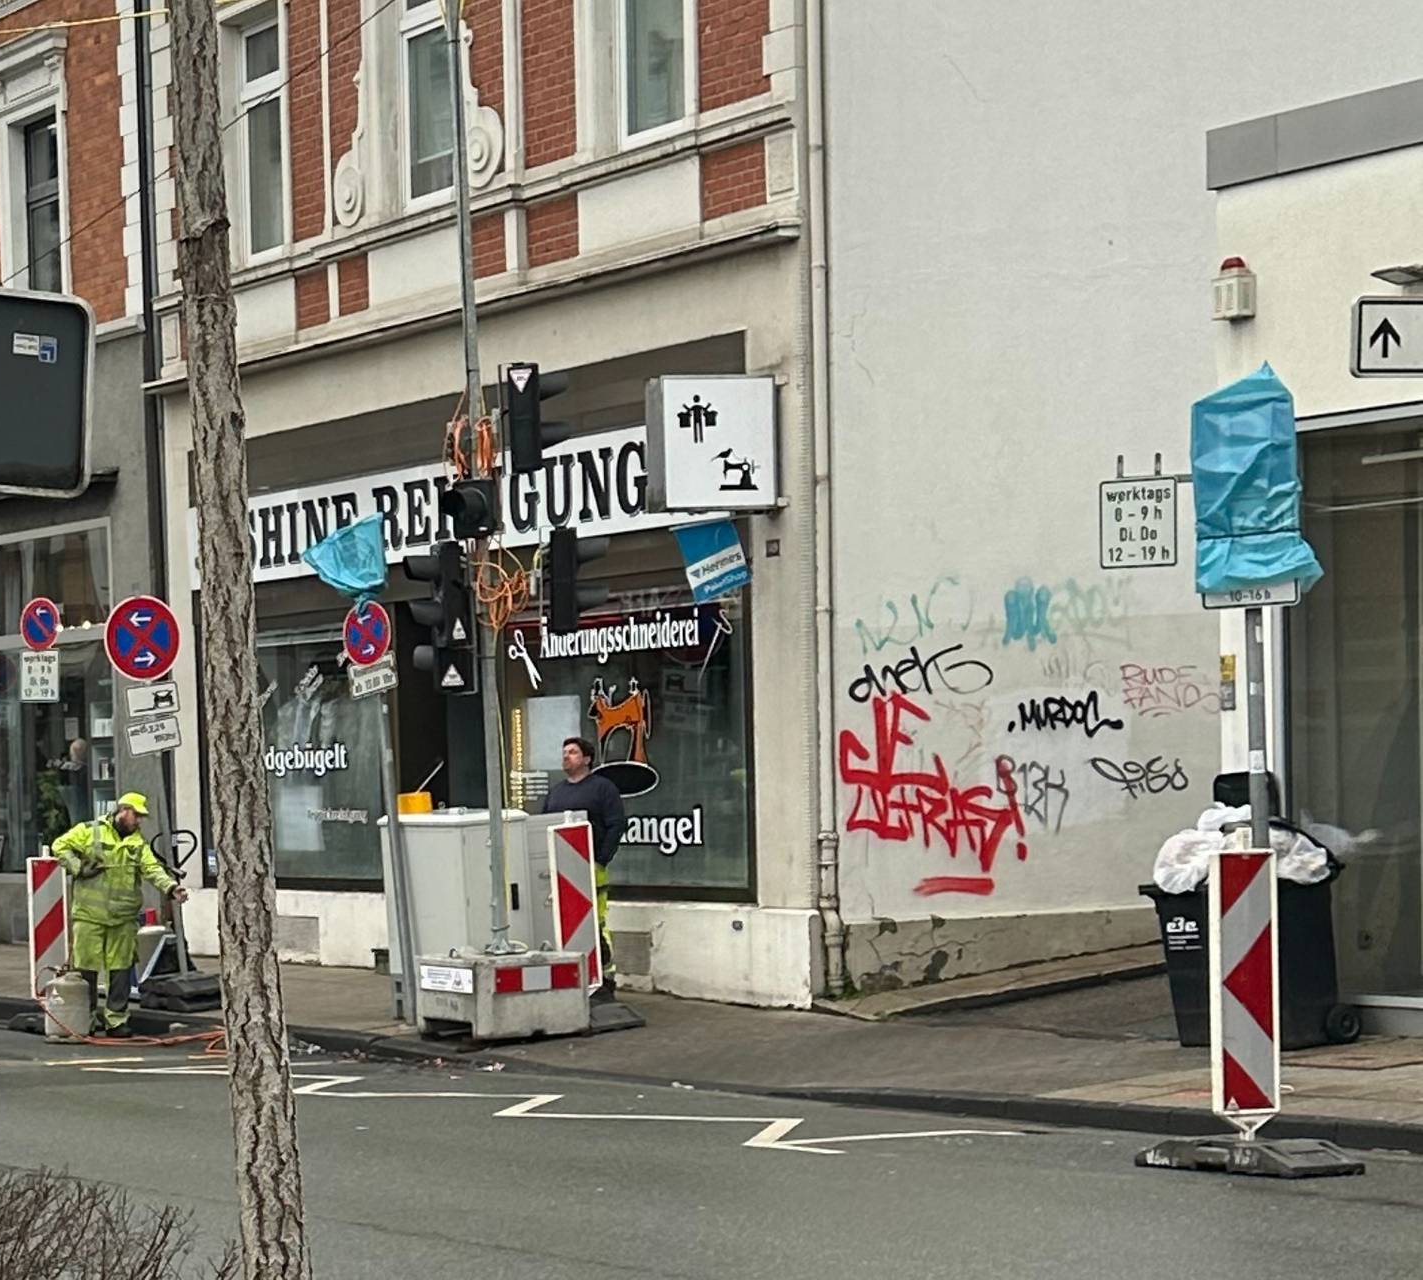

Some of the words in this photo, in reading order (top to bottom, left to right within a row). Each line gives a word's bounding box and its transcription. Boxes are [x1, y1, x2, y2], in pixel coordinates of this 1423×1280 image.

[372, 441, 648, 551] REIGUNG
[1106, 486, 1171, 503] werktags
[1115, 507, 1123, 522] 8
[1141, 505, 1148, 520] 9
[1154, 505, 1162, 520] h
[1141, 526, 1157, 541] Do
[1108, 547, 1123, 562] 12
[1141, 545, 1156, 561] 19
[1162, 545, 1169, 560] h
[264, 742, 347, 776] dgebügelt
[620, 807, 703, 854] angel
